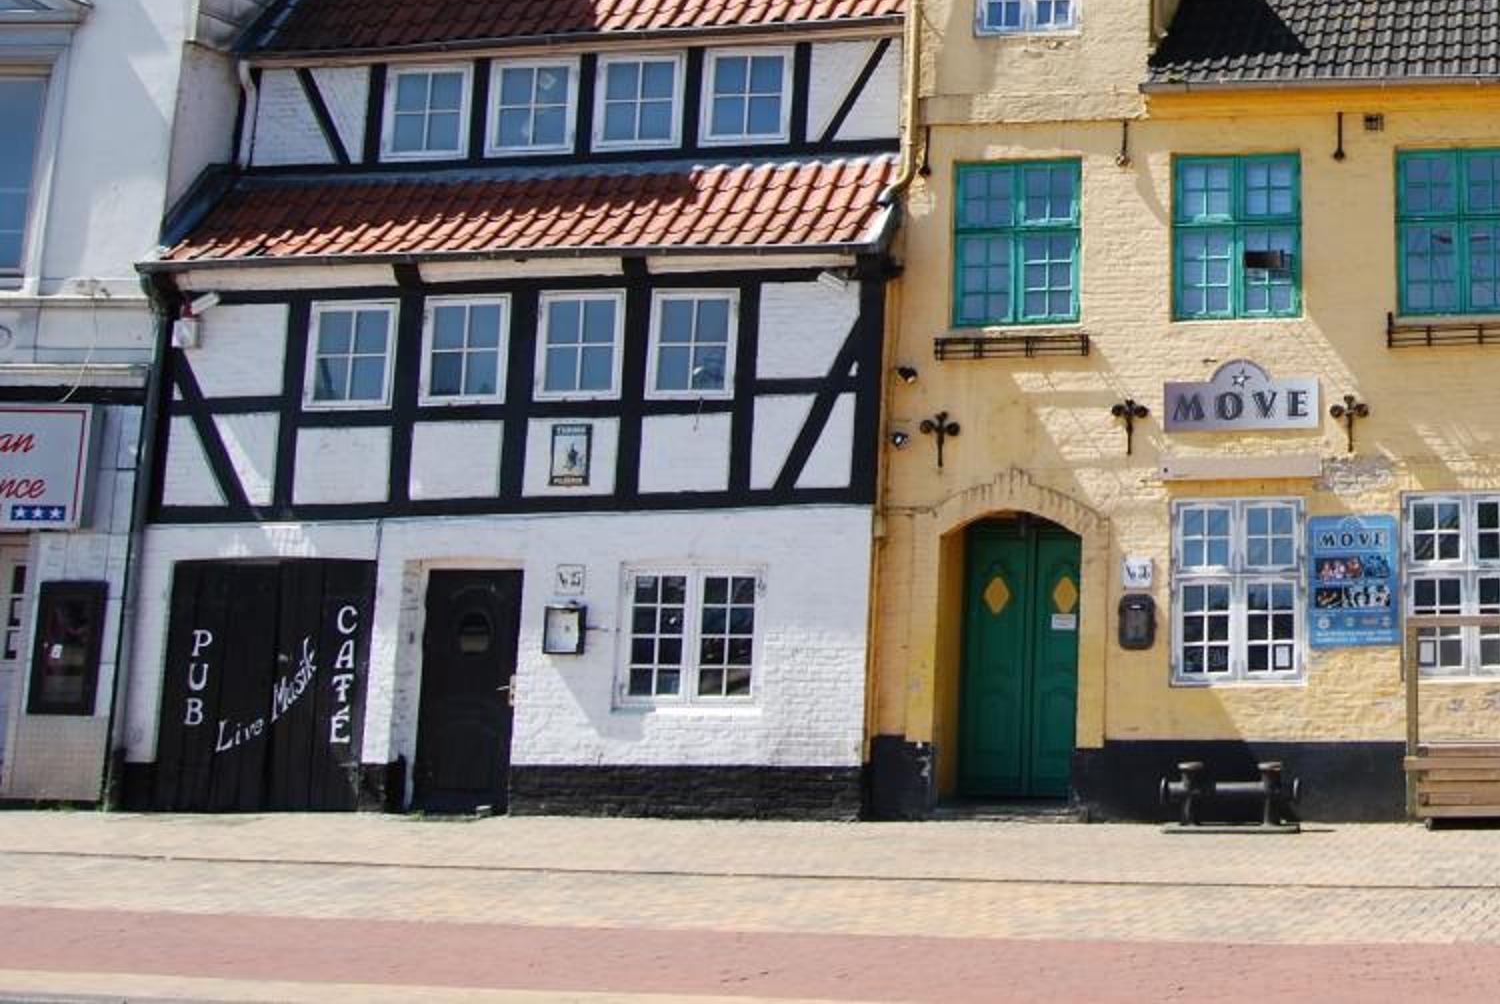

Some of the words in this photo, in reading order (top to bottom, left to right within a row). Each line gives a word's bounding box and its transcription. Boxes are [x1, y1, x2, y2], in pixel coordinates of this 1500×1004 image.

[1172, 390, 1309, 421] MOVE
[184, 629, 213, 725] PUB
[215, 718, 264, 753] Live
